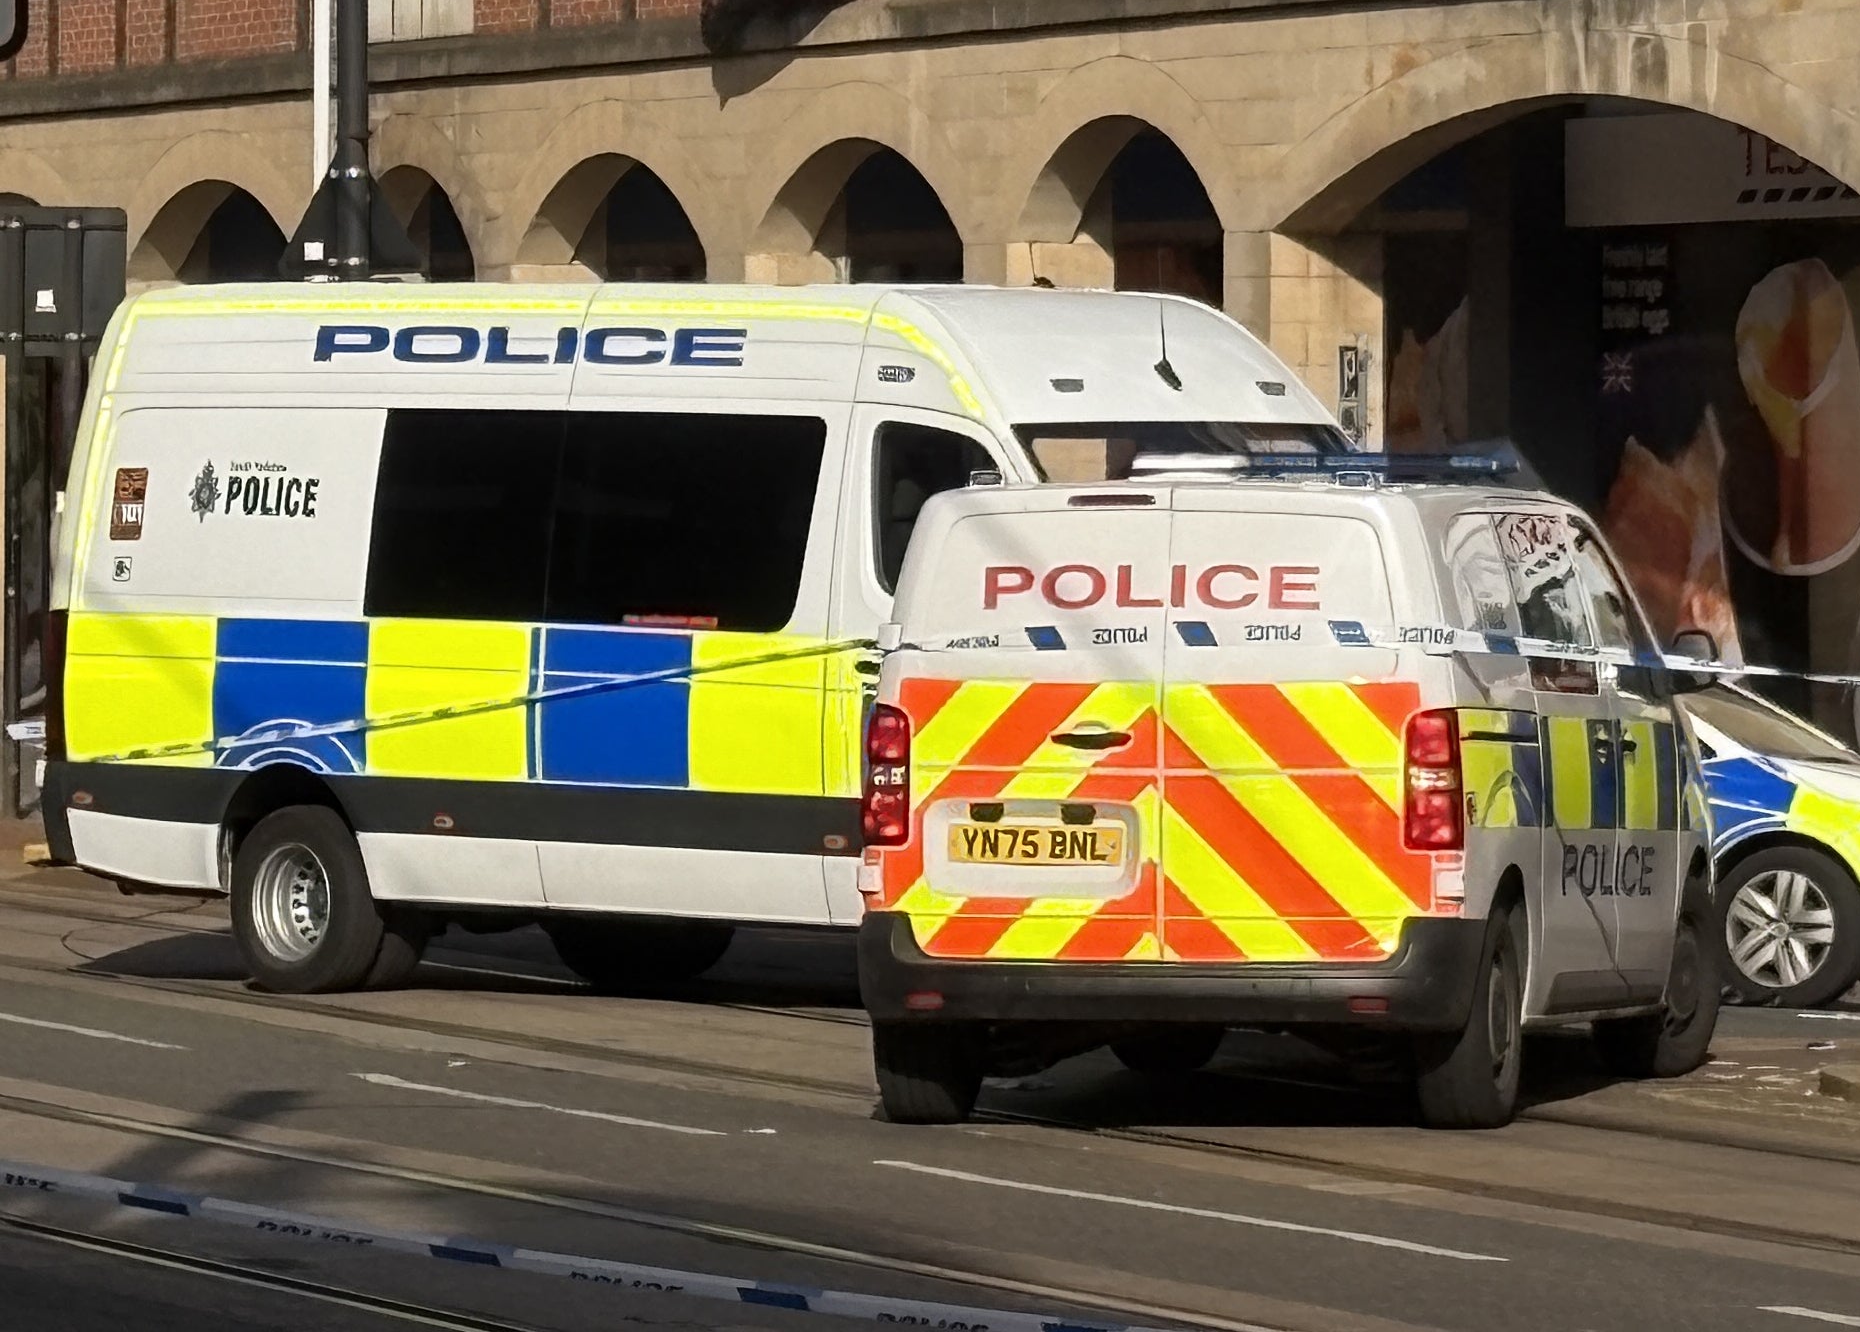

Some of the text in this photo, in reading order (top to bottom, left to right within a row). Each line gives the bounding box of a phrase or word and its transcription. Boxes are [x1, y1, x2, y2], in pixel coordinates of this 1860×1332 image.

[313, 325, 748, 366] POLICE
[224, 475, 320, 518] POLICE
[982, 564, 1321, 611] POLICE
[962, 828, 1108, 861] YN75 BNL
[1561, 843, 1656, 898] POLICE
